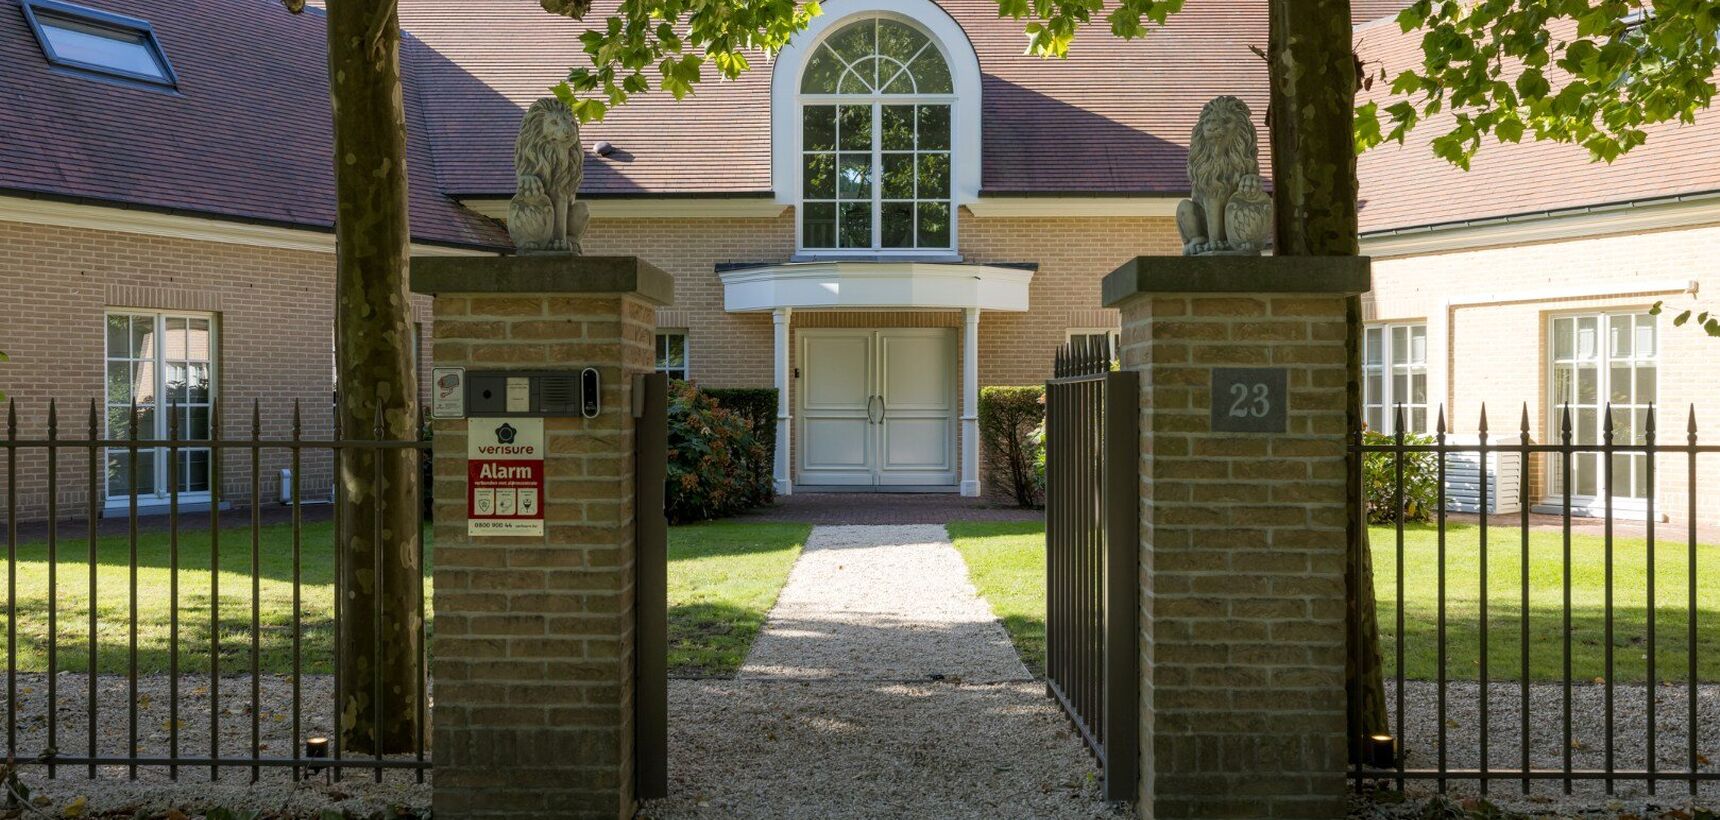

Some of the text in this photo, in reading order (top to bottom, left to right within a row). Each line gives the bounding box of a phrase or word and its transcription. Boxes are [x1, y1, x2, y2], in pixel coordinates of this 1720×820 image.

[1229, 383, 1270, 417] 23
[478, 445, 534, 454] verisure
[480, 463, 531, 479] Alarm
